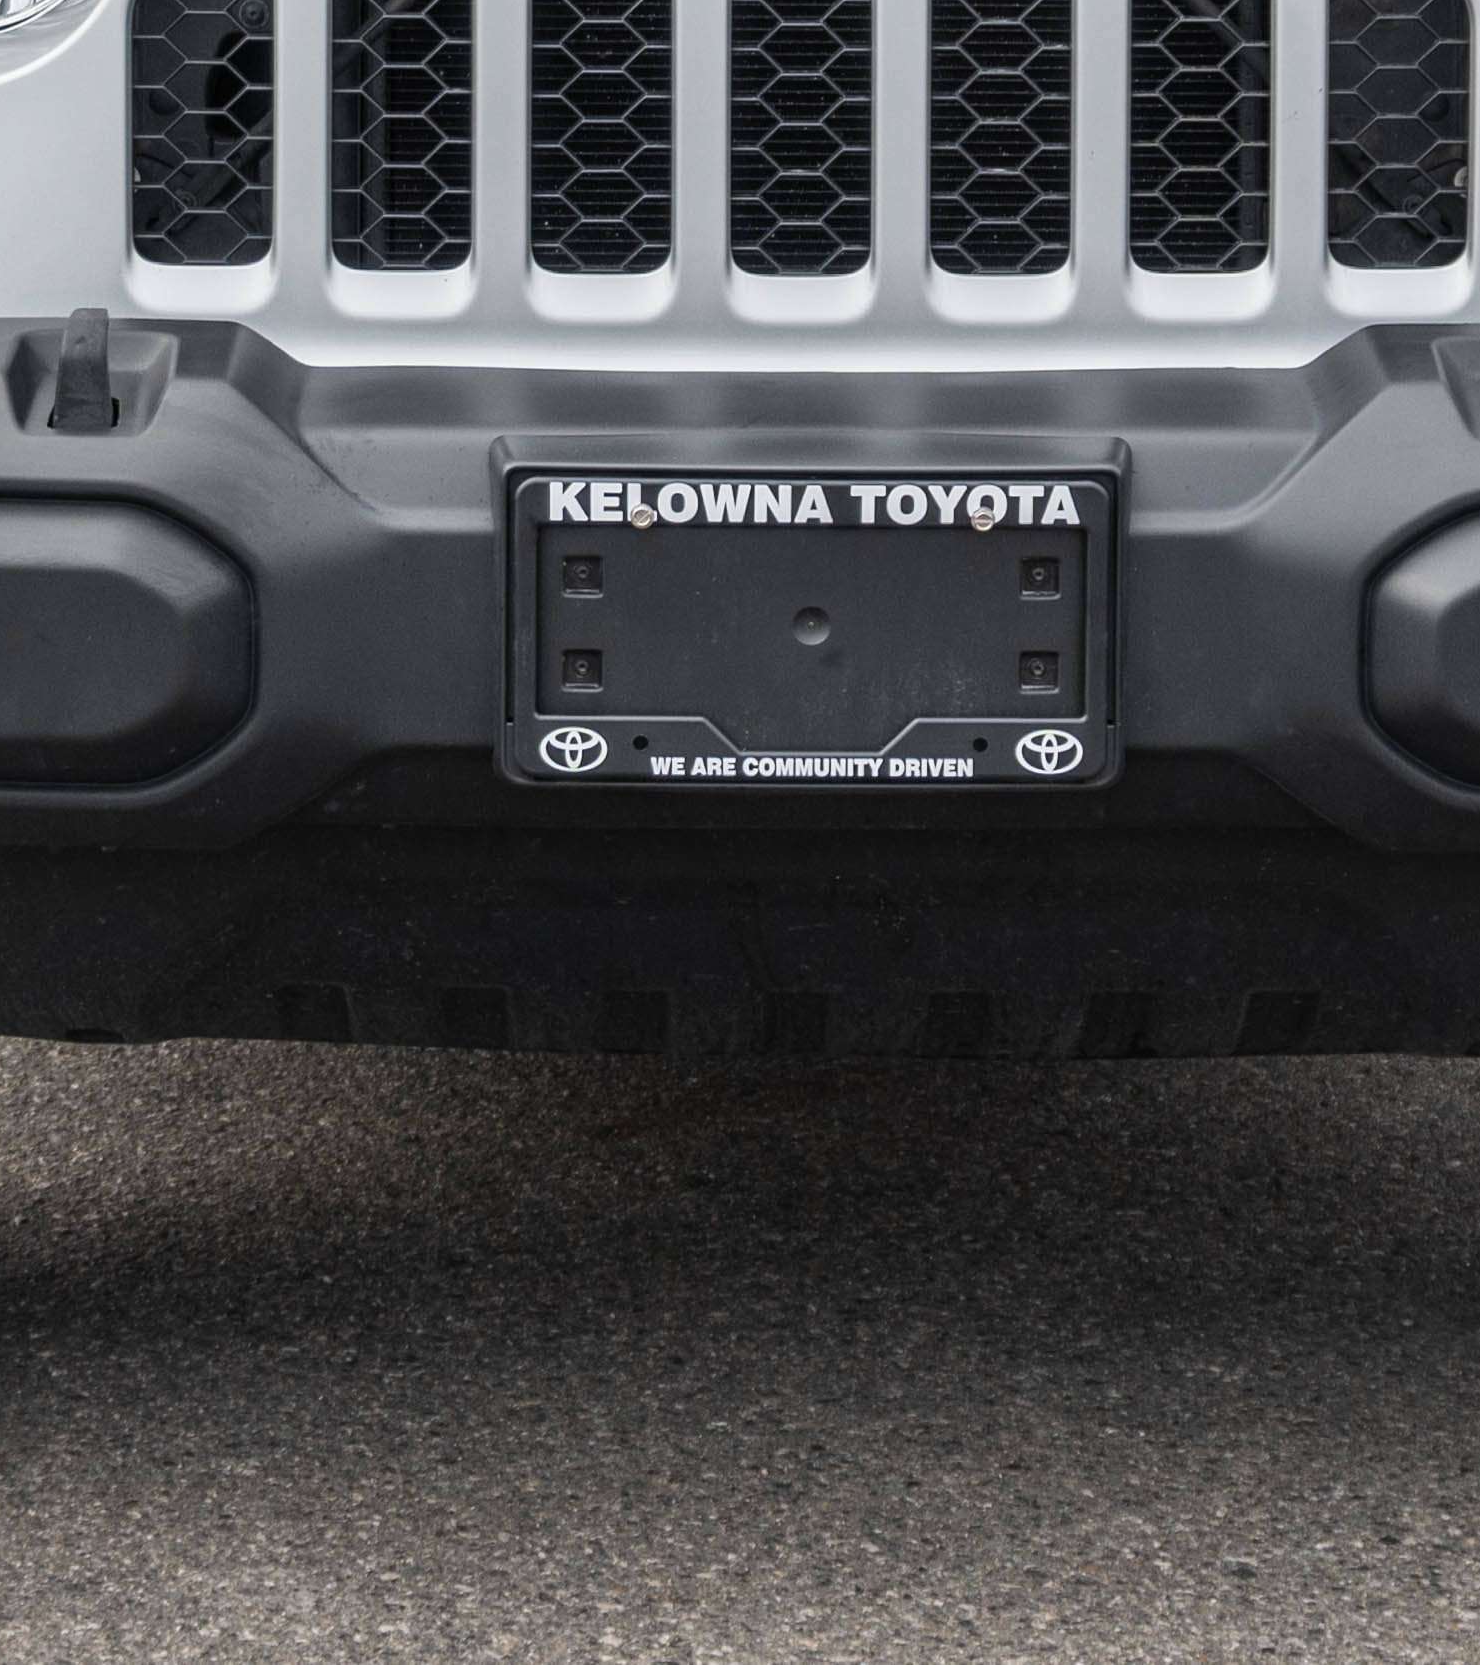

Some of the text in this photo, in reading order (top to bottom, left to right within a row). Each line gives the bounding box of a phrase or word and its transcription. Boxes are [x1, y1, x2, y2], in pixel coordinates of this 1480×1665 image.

[549, 481, 1081, 526] KELOWNA TOYOTA
[650, 756, 975, 778] WE ARE COMMUNITY DRIVEN
